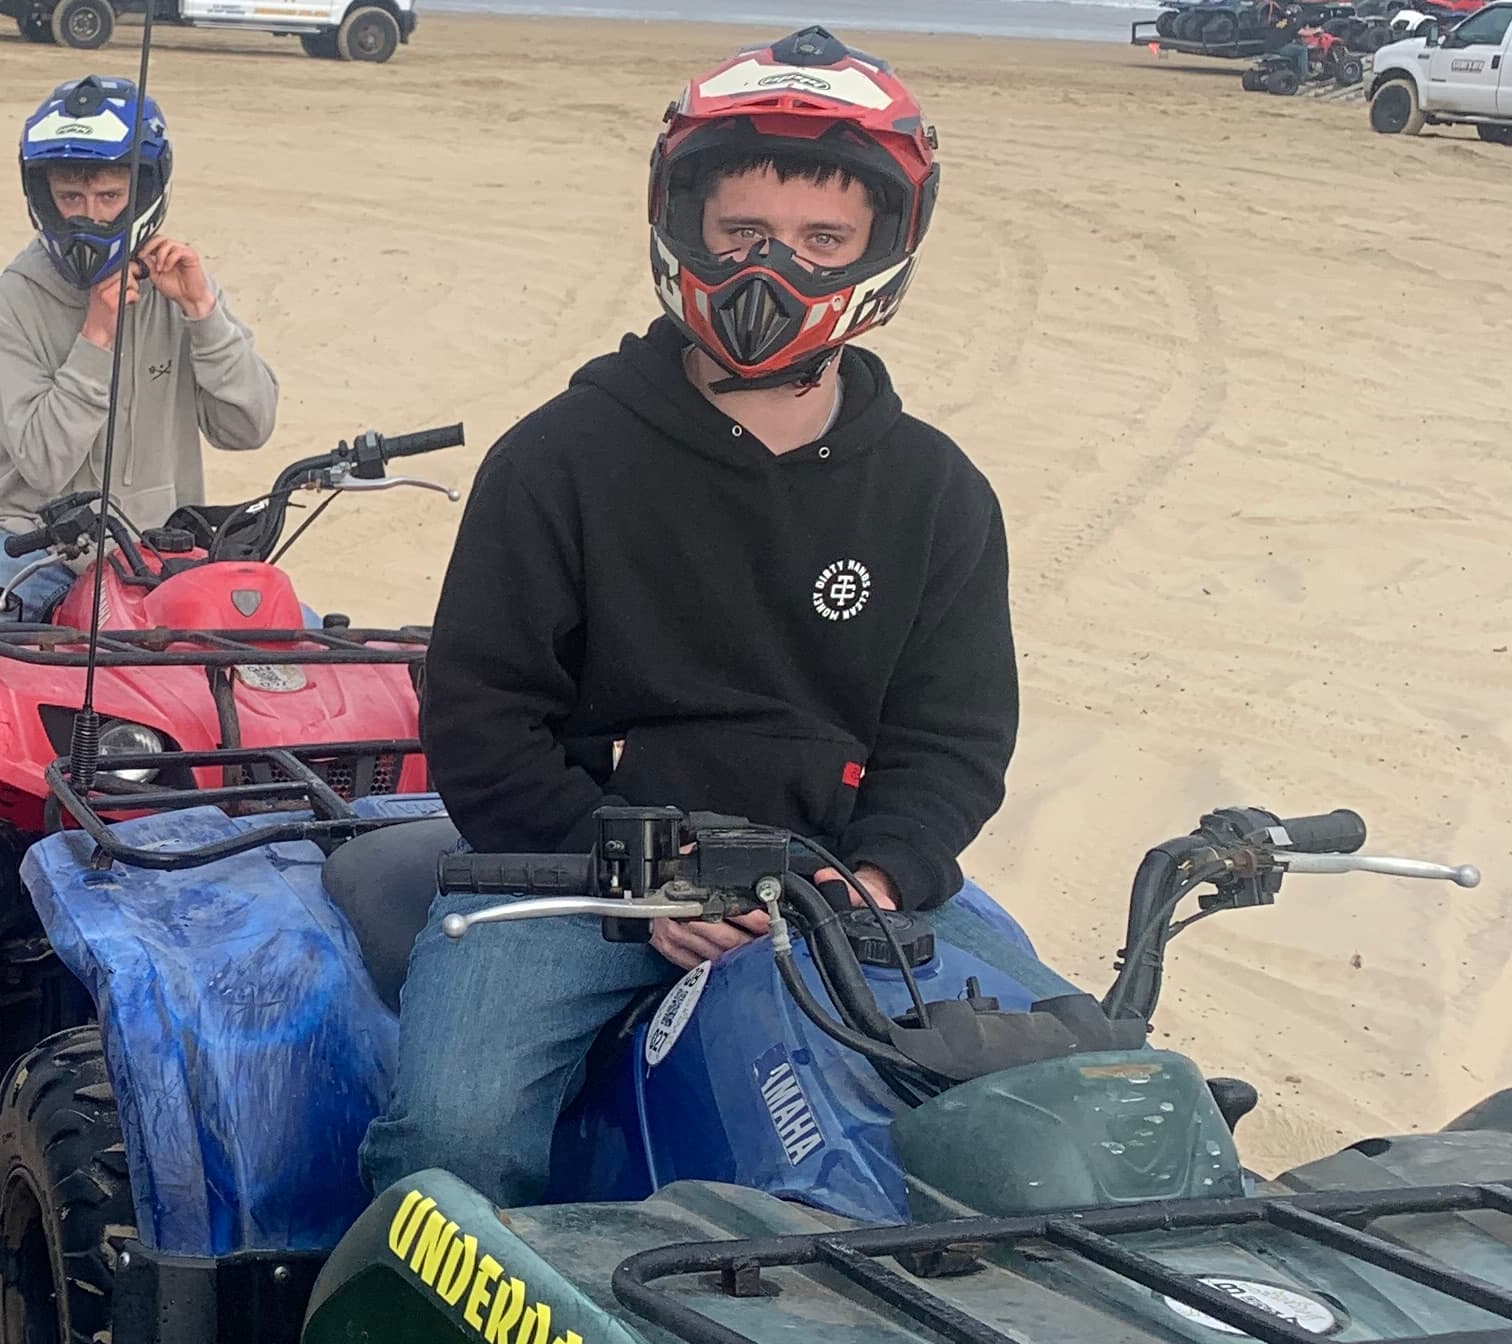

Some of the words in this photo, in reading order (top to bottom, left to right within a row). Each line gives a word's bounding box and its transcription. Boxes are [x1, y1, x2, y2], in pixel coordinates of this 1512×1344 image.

[815, 560, 844, 589] DIRTY
[848, 559, 871, 588] HANDS
[812, 592, 840, 621] MONEY
[842, 590, 870, 620] CLEAN
